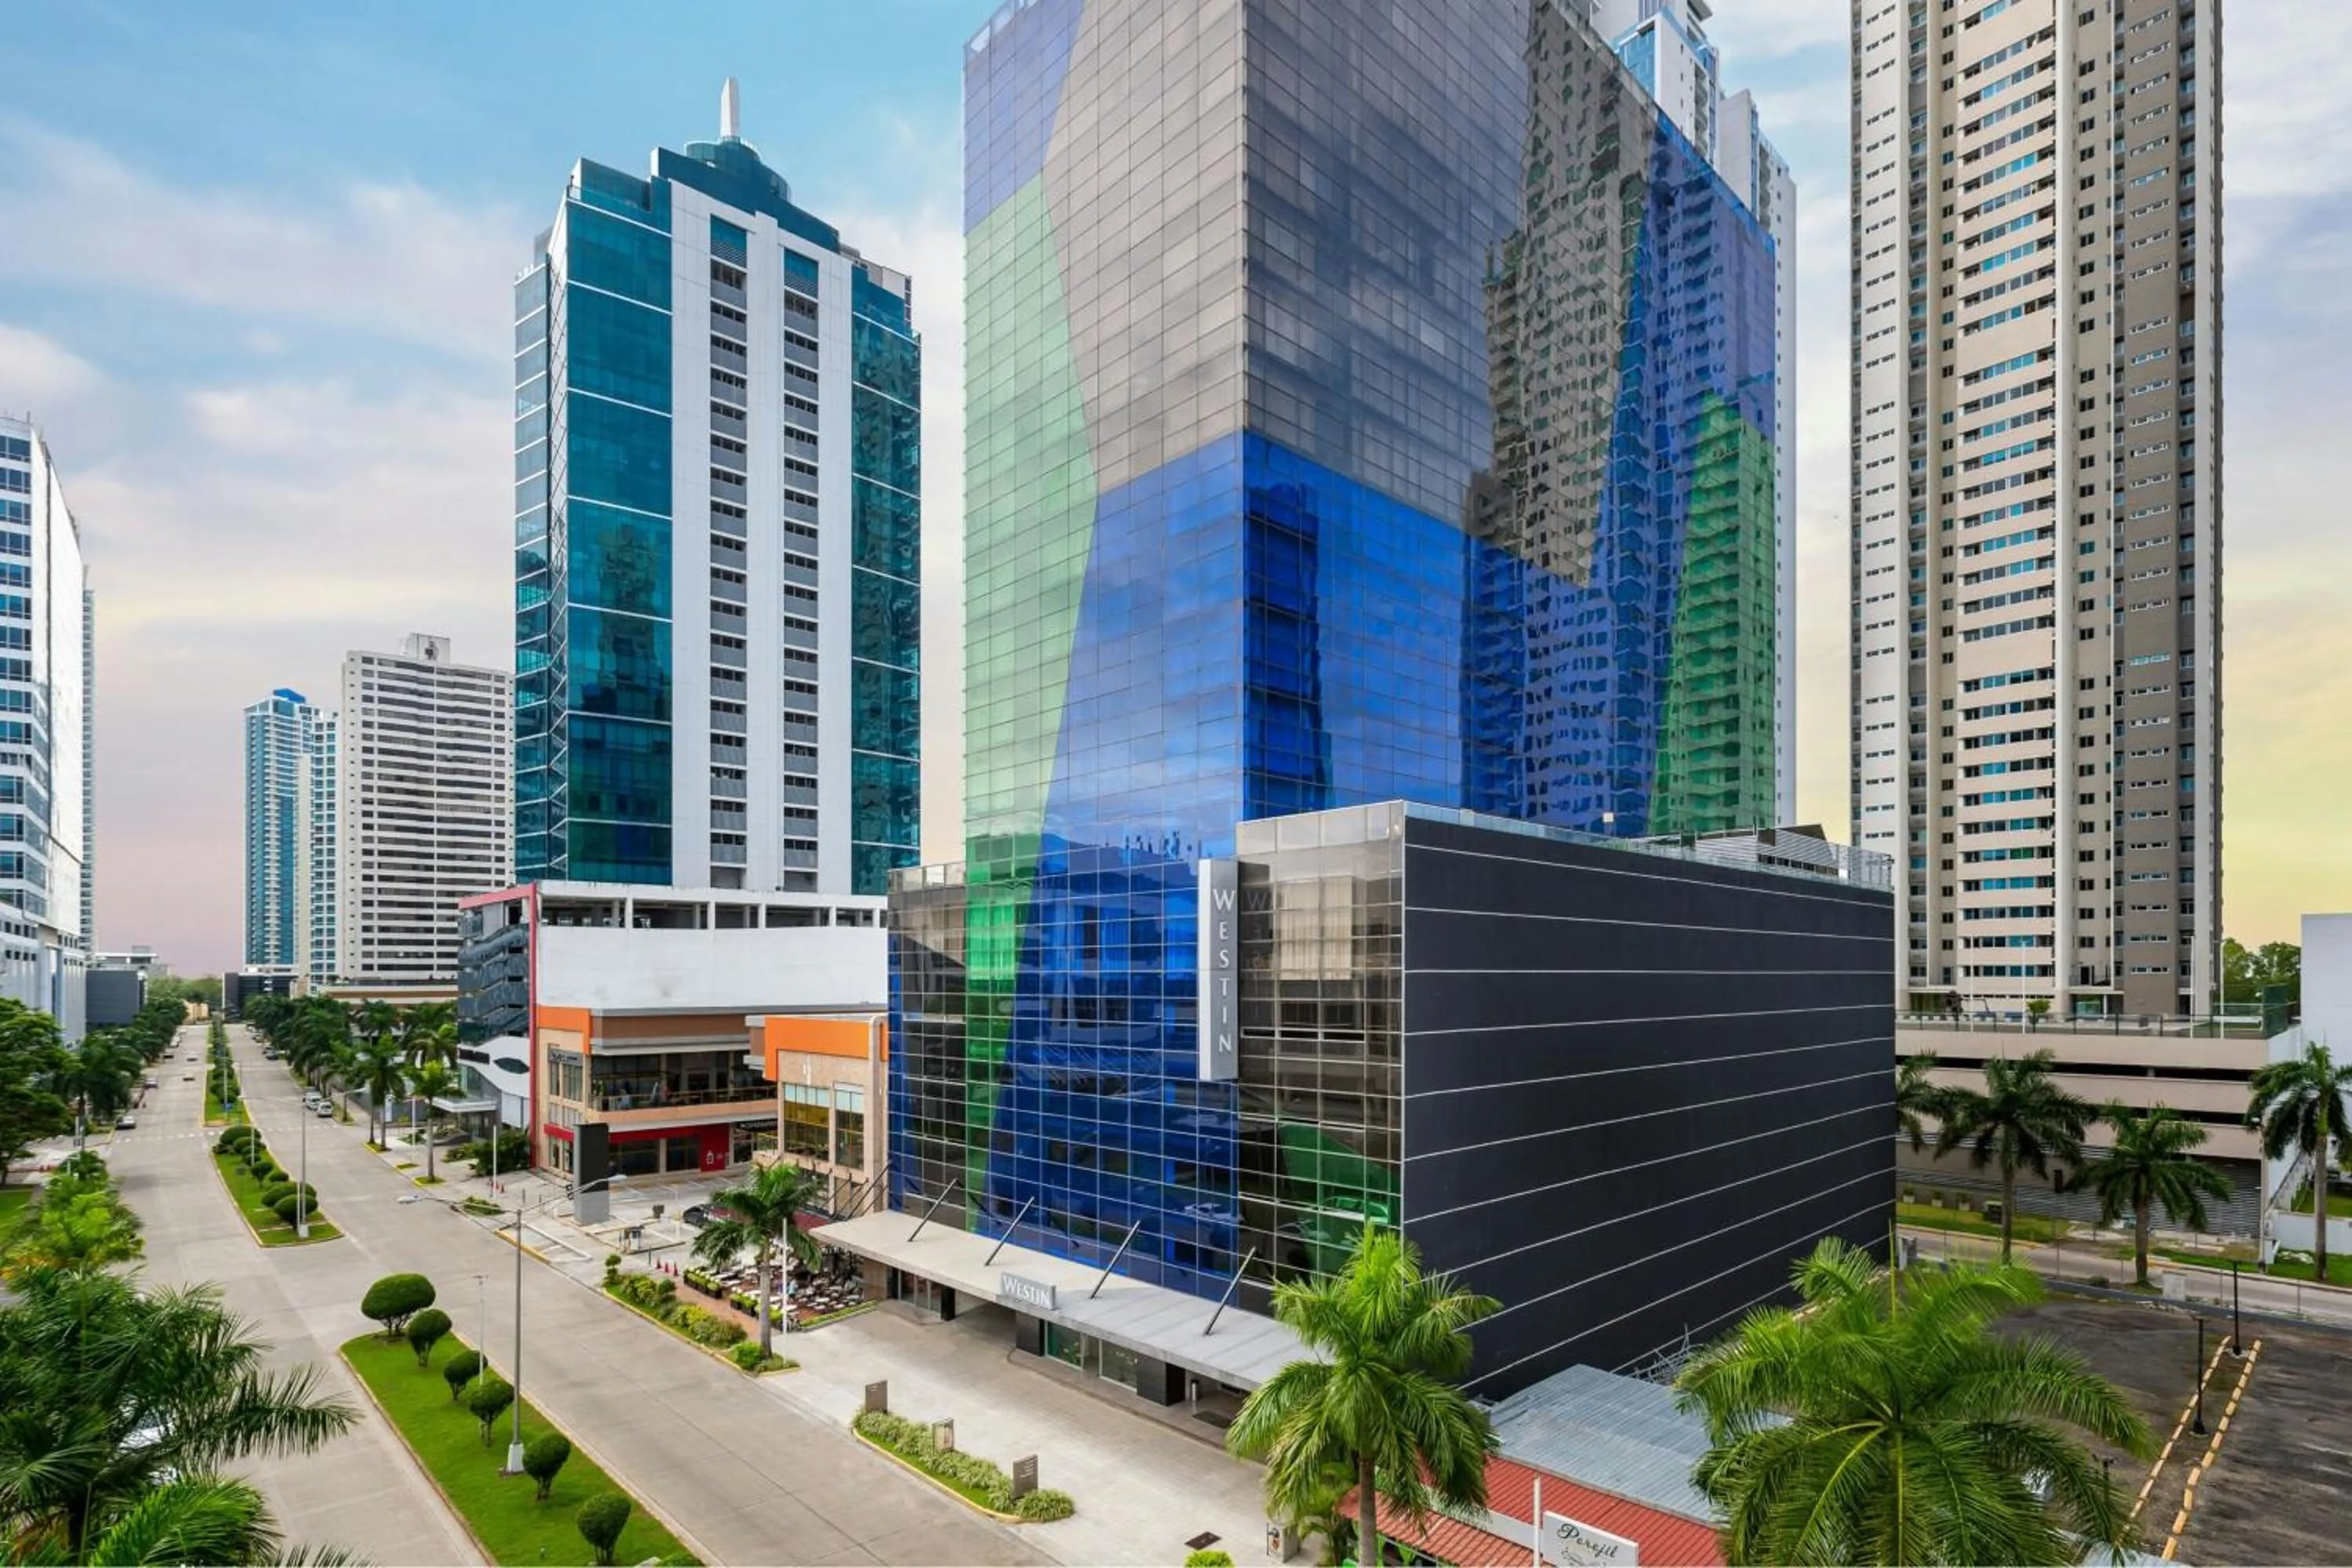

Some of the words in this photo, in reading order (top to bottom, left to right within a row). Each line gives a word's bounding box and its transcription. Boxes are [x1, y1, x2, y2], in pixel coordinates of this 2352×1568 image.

[1212, 888, 1236, 1053] WESTIN
[1004, 1275, 1053, 1309] WESTIN
[1557, 1523, 1618, 1558] Perejil
